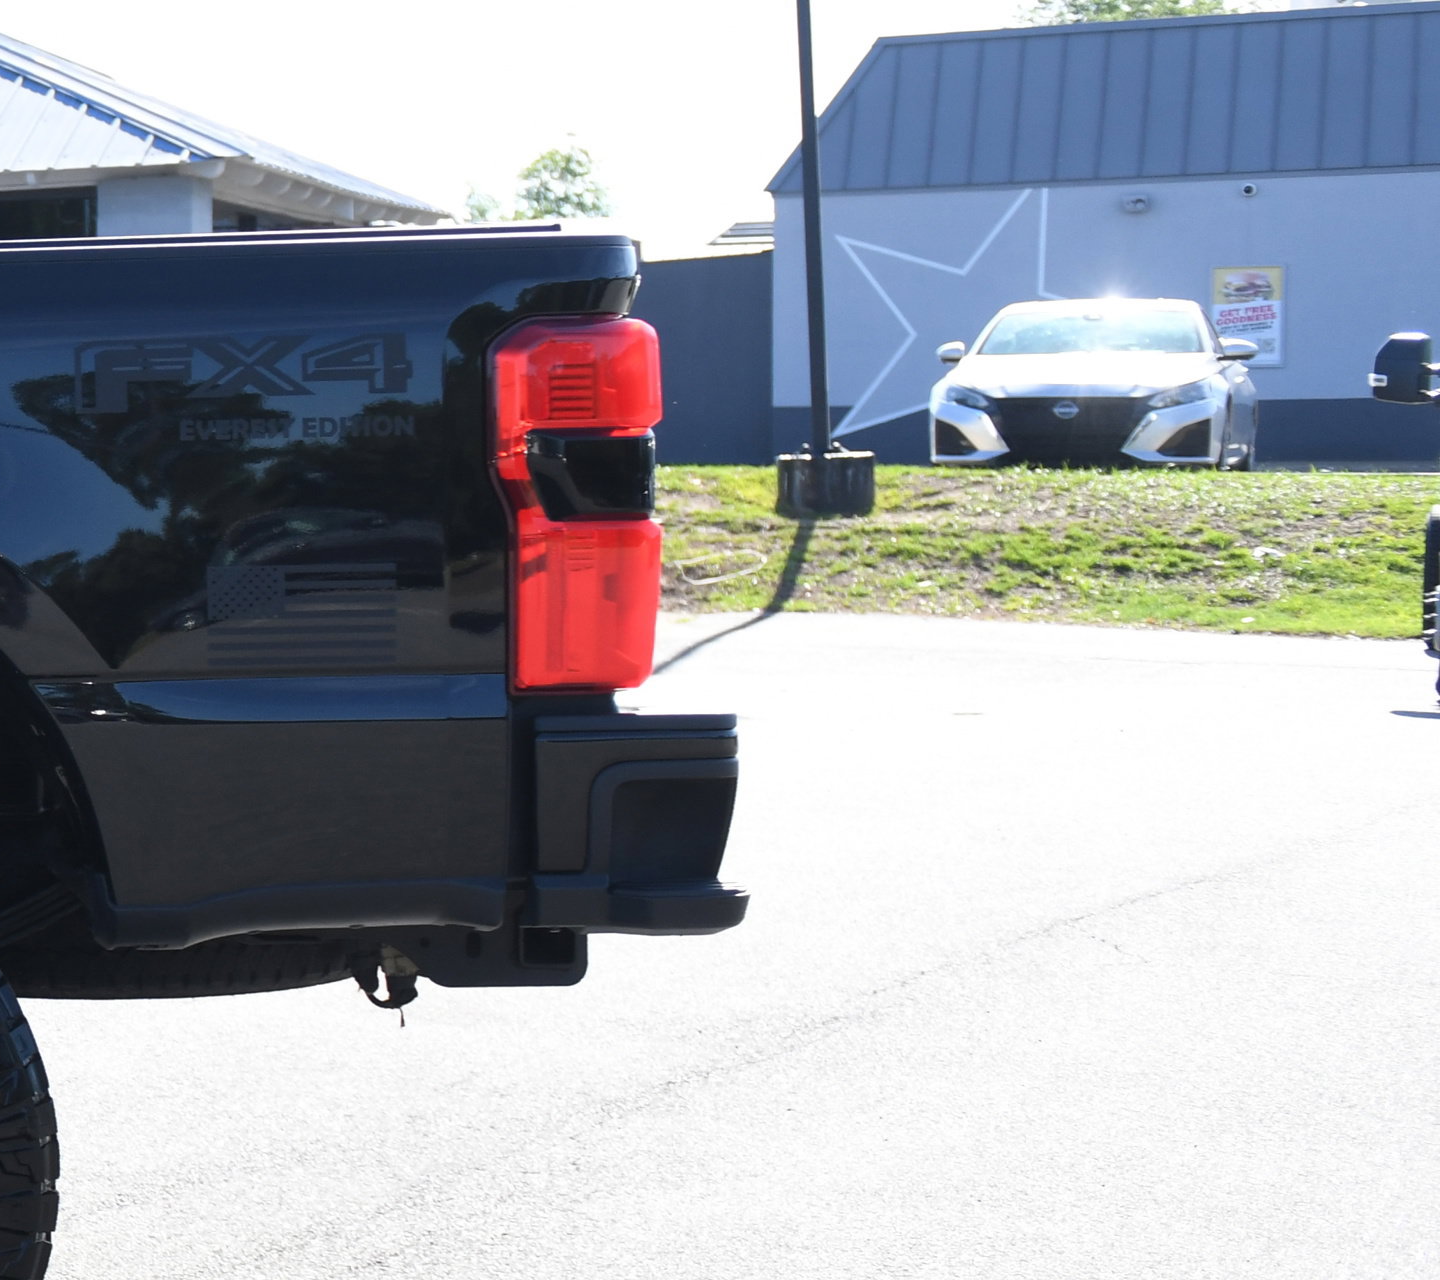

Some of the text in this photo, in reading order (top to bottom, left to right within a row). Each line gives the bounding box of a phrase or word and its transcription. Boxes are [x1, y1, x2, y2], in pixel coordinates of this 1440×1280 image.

[1216, 312, 1277, 326] GOODNESS
[1245, 304, 1274, 314] FREE
[75, 332, 413, 414] FX4
[181, 415, 415, 442] EVEREST EDITION
